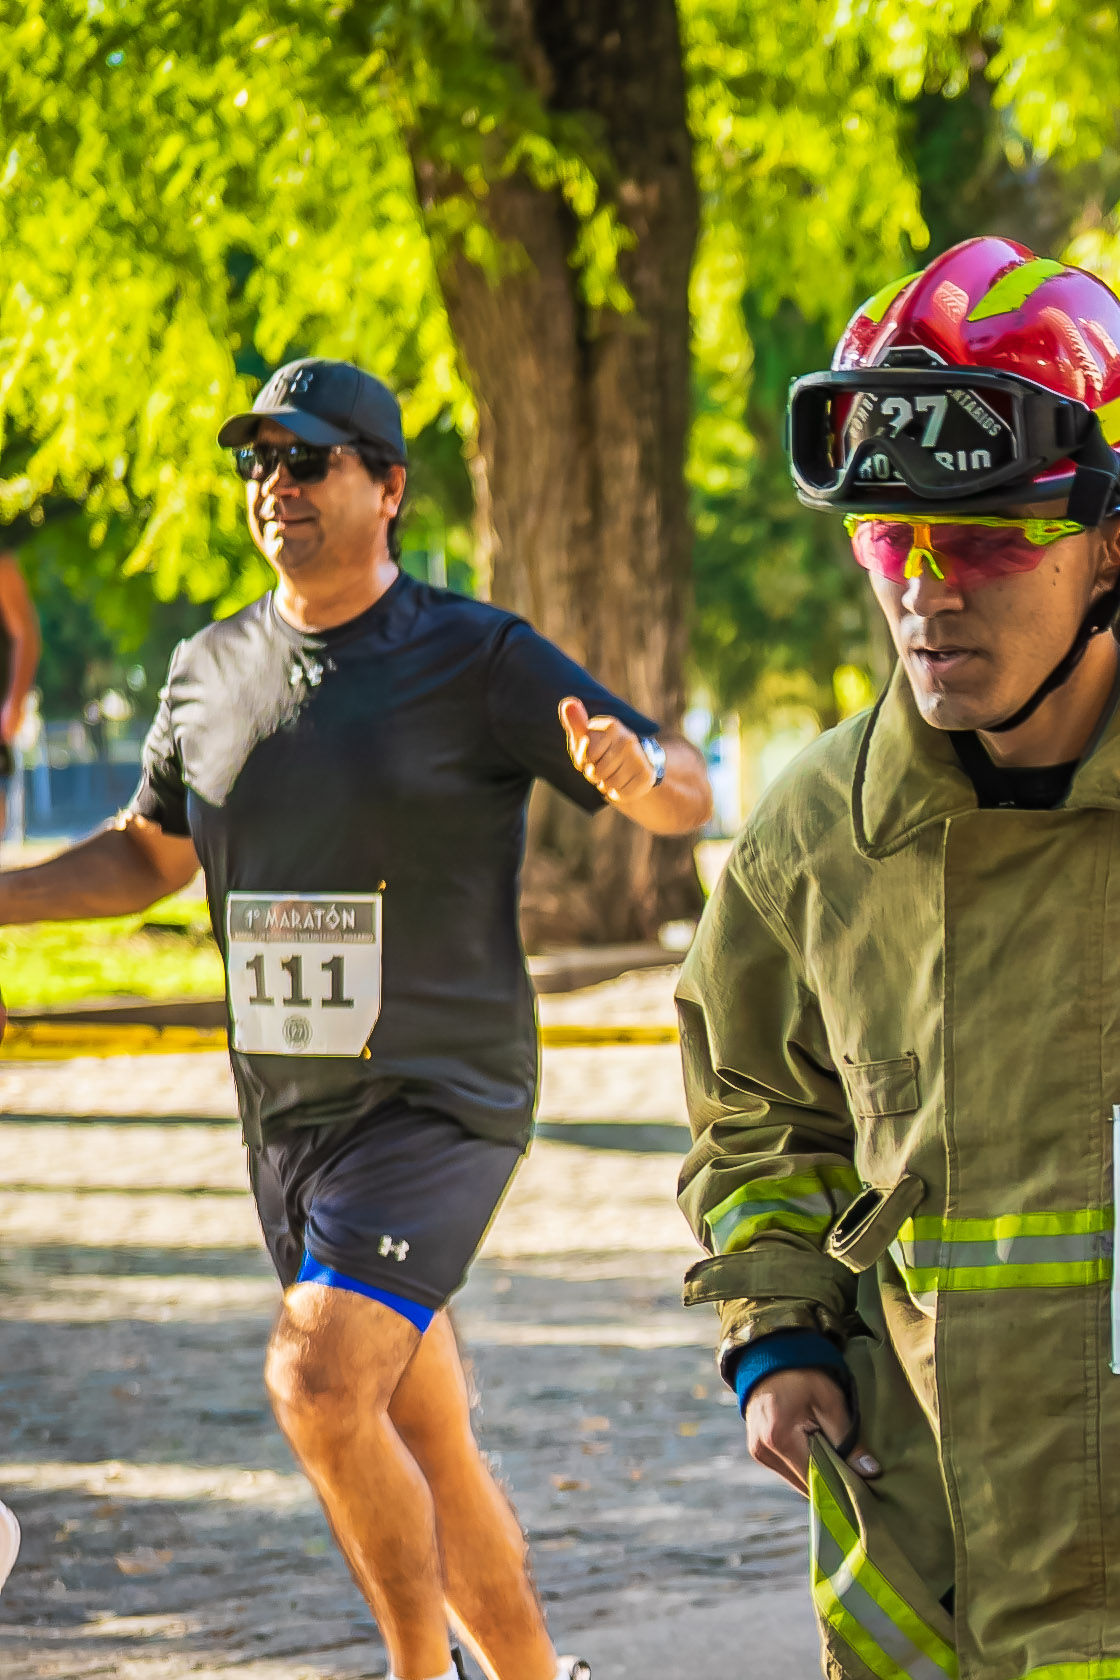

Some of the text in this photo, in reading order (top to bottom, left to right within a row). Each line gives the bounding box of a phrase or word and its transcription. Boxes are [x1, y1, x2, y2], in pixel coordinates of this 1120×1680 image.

[874, 396, 949, 448] 27
[265, 903, 356, 930] MARATÓN
[245, 953, 355, 1009] 111
